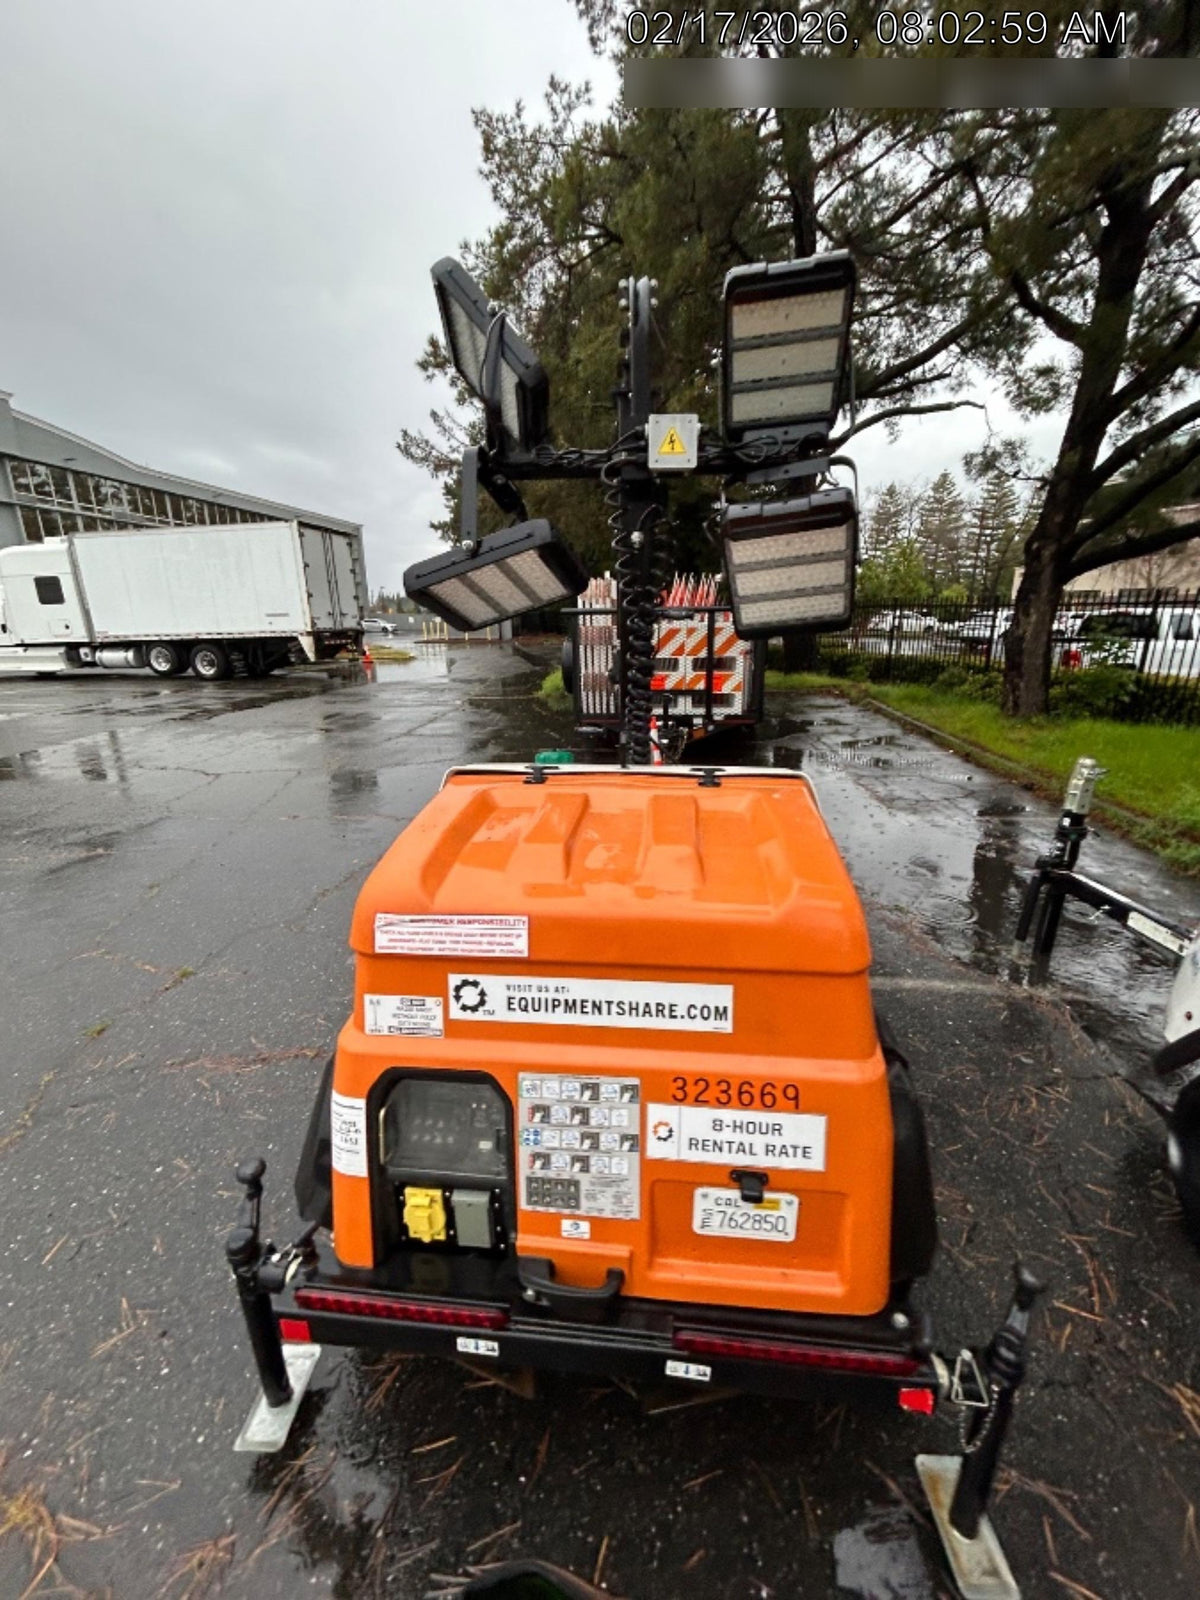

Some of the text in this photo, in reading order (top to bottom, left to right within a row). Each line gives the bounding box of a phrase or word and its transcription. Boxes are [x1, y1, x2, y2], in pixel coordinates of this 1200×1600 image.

[505, 984, 533, 993] VISIT
[536, 985, 550, 993] US
[506, 996, 729, 1022] EQUIPMENTSHARE.COM
[671, 1076, 800, 1110] 323669
[712, 1118, 784, 1137] 8-HOUR
[688, 1137, 813, 1160] RENTAL RATE
[716, 1210, 788, 1233] 762850
